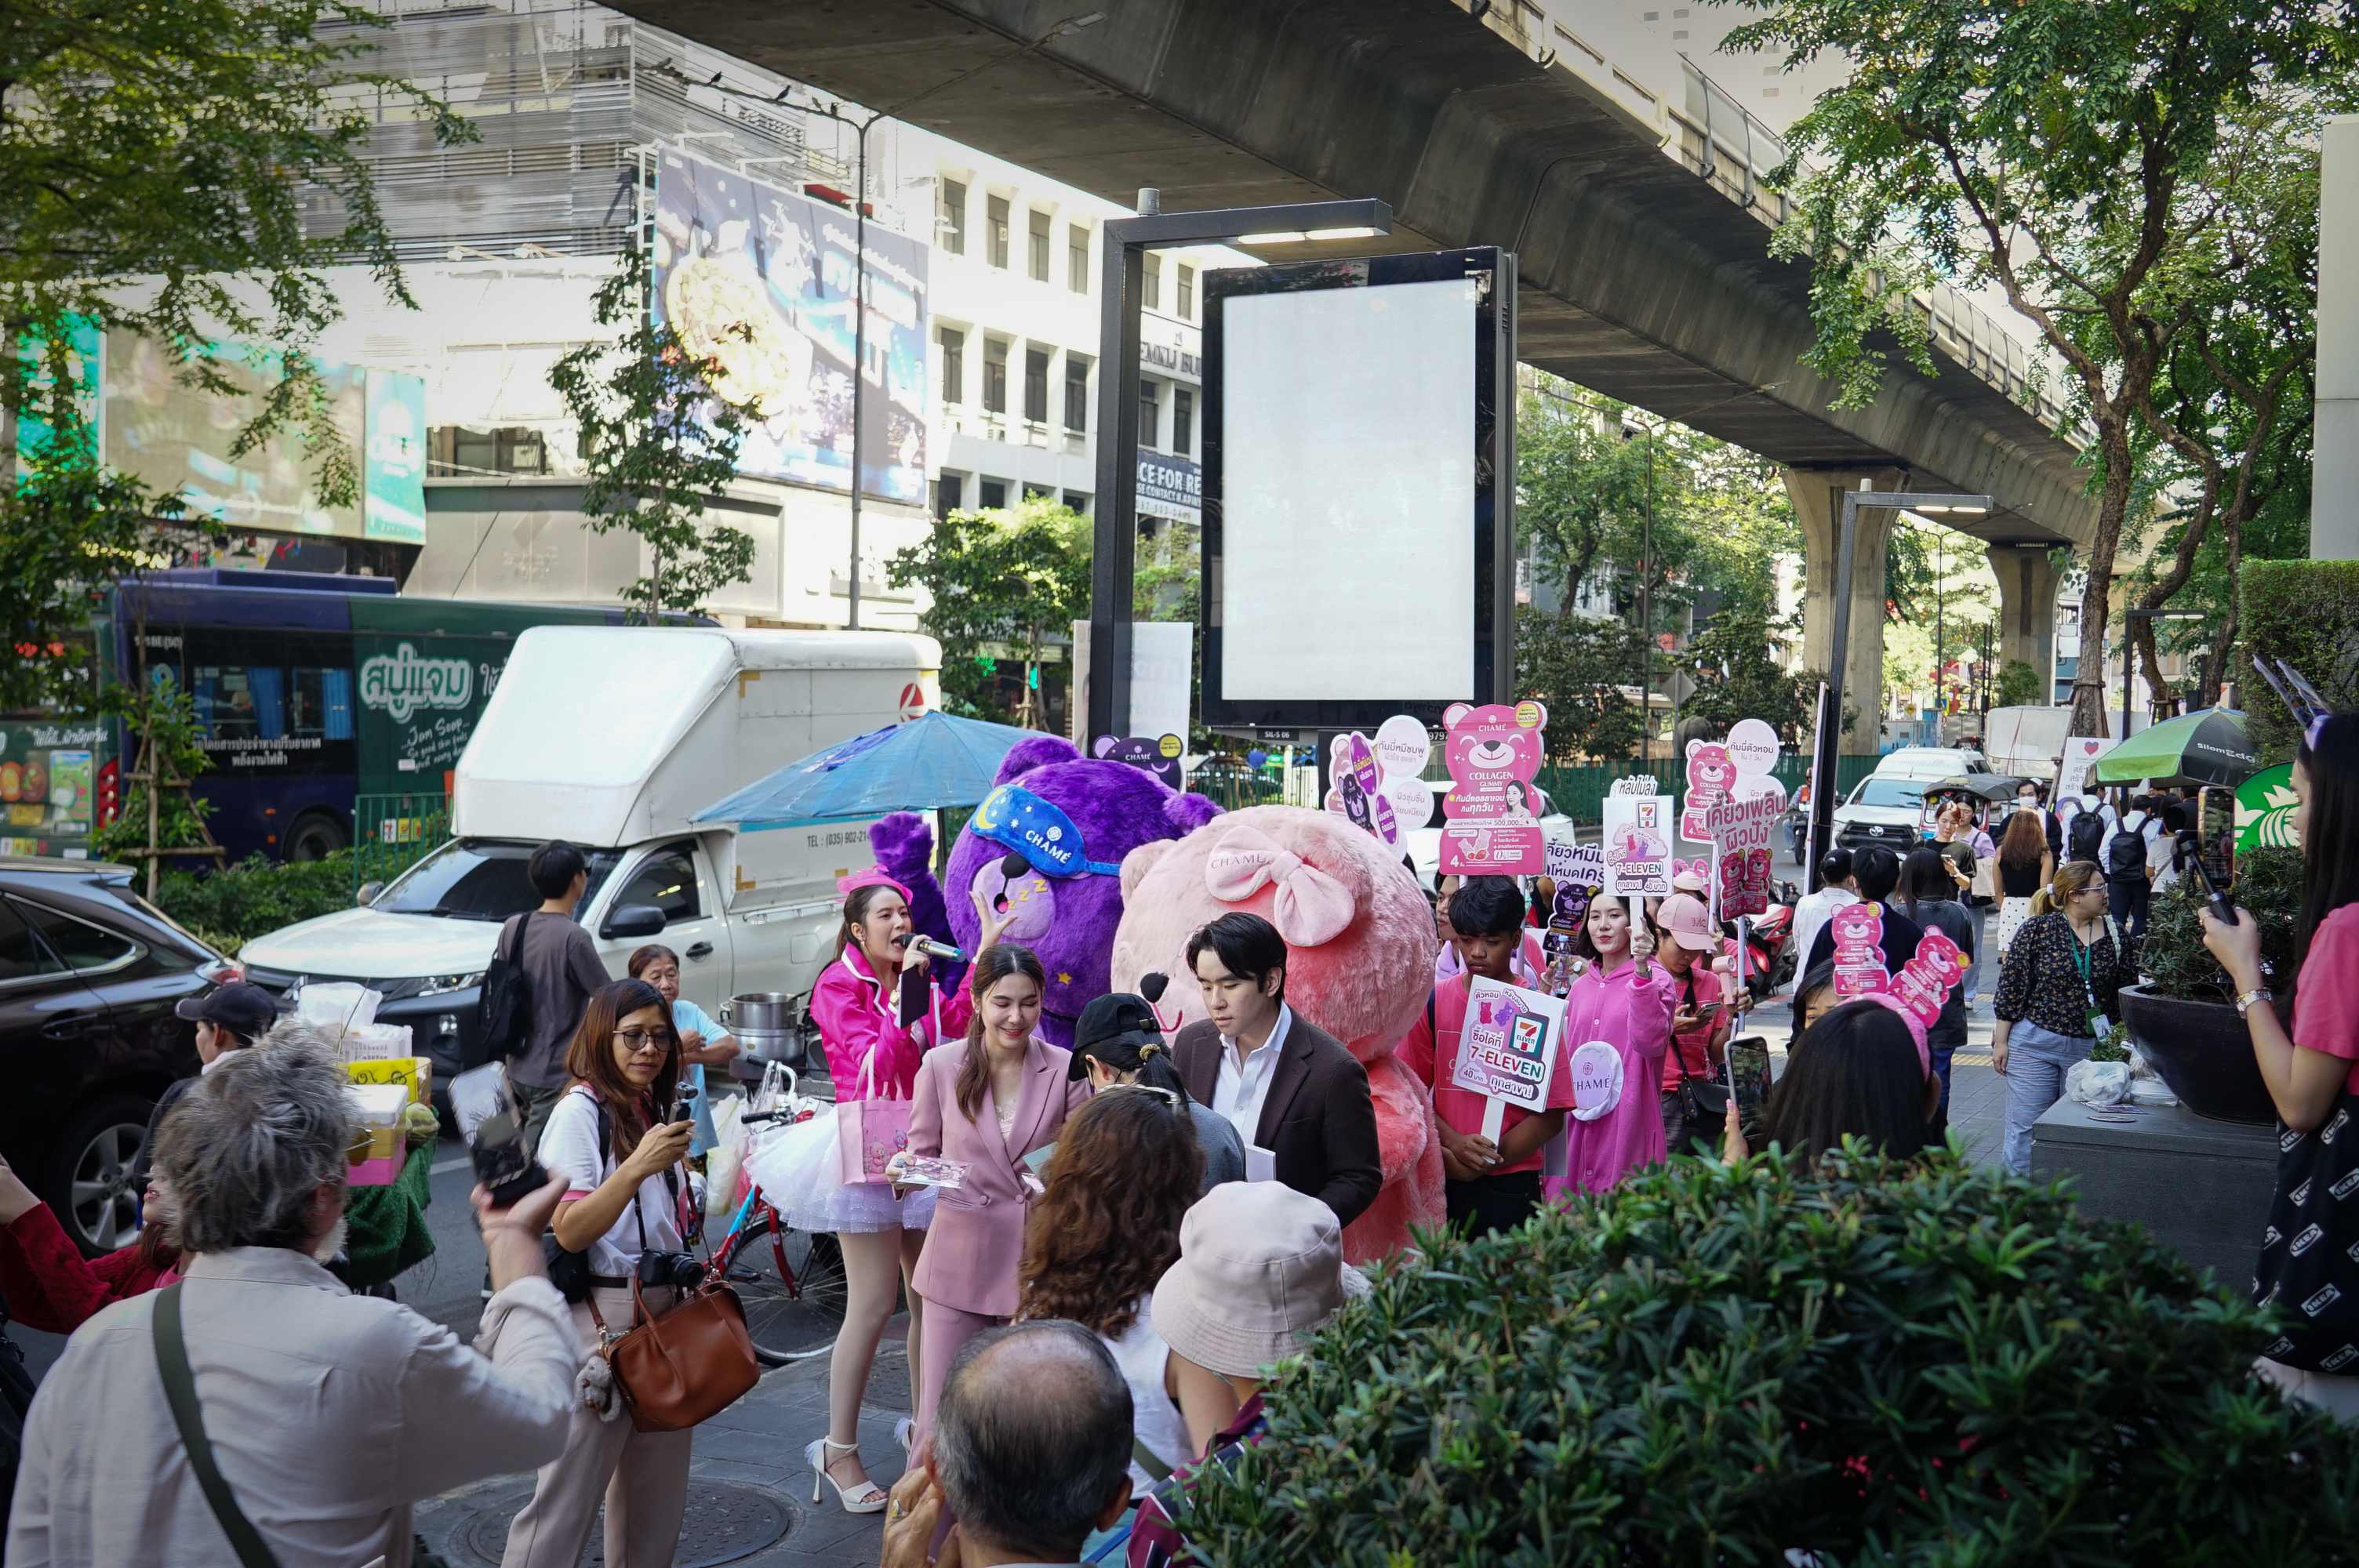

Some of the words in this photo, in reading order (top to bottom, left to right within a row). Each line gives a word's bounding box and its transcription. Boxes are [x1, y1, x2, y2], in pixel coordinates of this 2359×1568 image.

[1158, 466, 1183, 491] FOR
[1146, 485, 1176, 501] CONTACT
[364, 646, 469, 715] สบู่แจม
[1379, 739, 1425, 758] กัมมี่หมีชมพู
[1730, 739, 1774, 753] กัมมี่ตัวหอม
[2197, 742, 2256, 764] SilomEdg
[1125, 752, 1151, 762] CHAMÉ
[1469, 771, 1514, 781] COLLAGEN
[1456, 793, 1506, 803] กัมมี่คอลลาเจน
[1396, 808, 1426, 817] รียบเนียน
[1460, 803, 1494, 815] กินทุกวัน
[1706, 792, 1786, 829] เคี้ยวเพลิน
[807, 835, 819, 848] TEL
[826, 833, 844, 848] (035)
[1725, 820, 1768, 850] ผิวปัง
[1025, 829, 1072, 864] CHAMÉ
[1450, 855, 1459, 868] 4
[1616, 863, 1662, 874] 7-ELEVEN
[1475, 990, 1499, 1000] ตัวหอม
[1473, 1025, 1503, 1048] ซื้อได้ที่
[1470, 1046, 1541, 1078] 7-ELEVEN
[1463, 1069, 1474, 1078] 40
[1491, 1076, 1532, 1098] ทุกสาขา!
[2281, 1131, 2302, 1148] IKE
[2335, 1174, 2359, 1196] IKEA
[2292, 1229, 2318, 1251] IKEA
[2306, 1288, 2335, 1312] IKEA
[2324, 1348, 2354, 1368] IKEA
